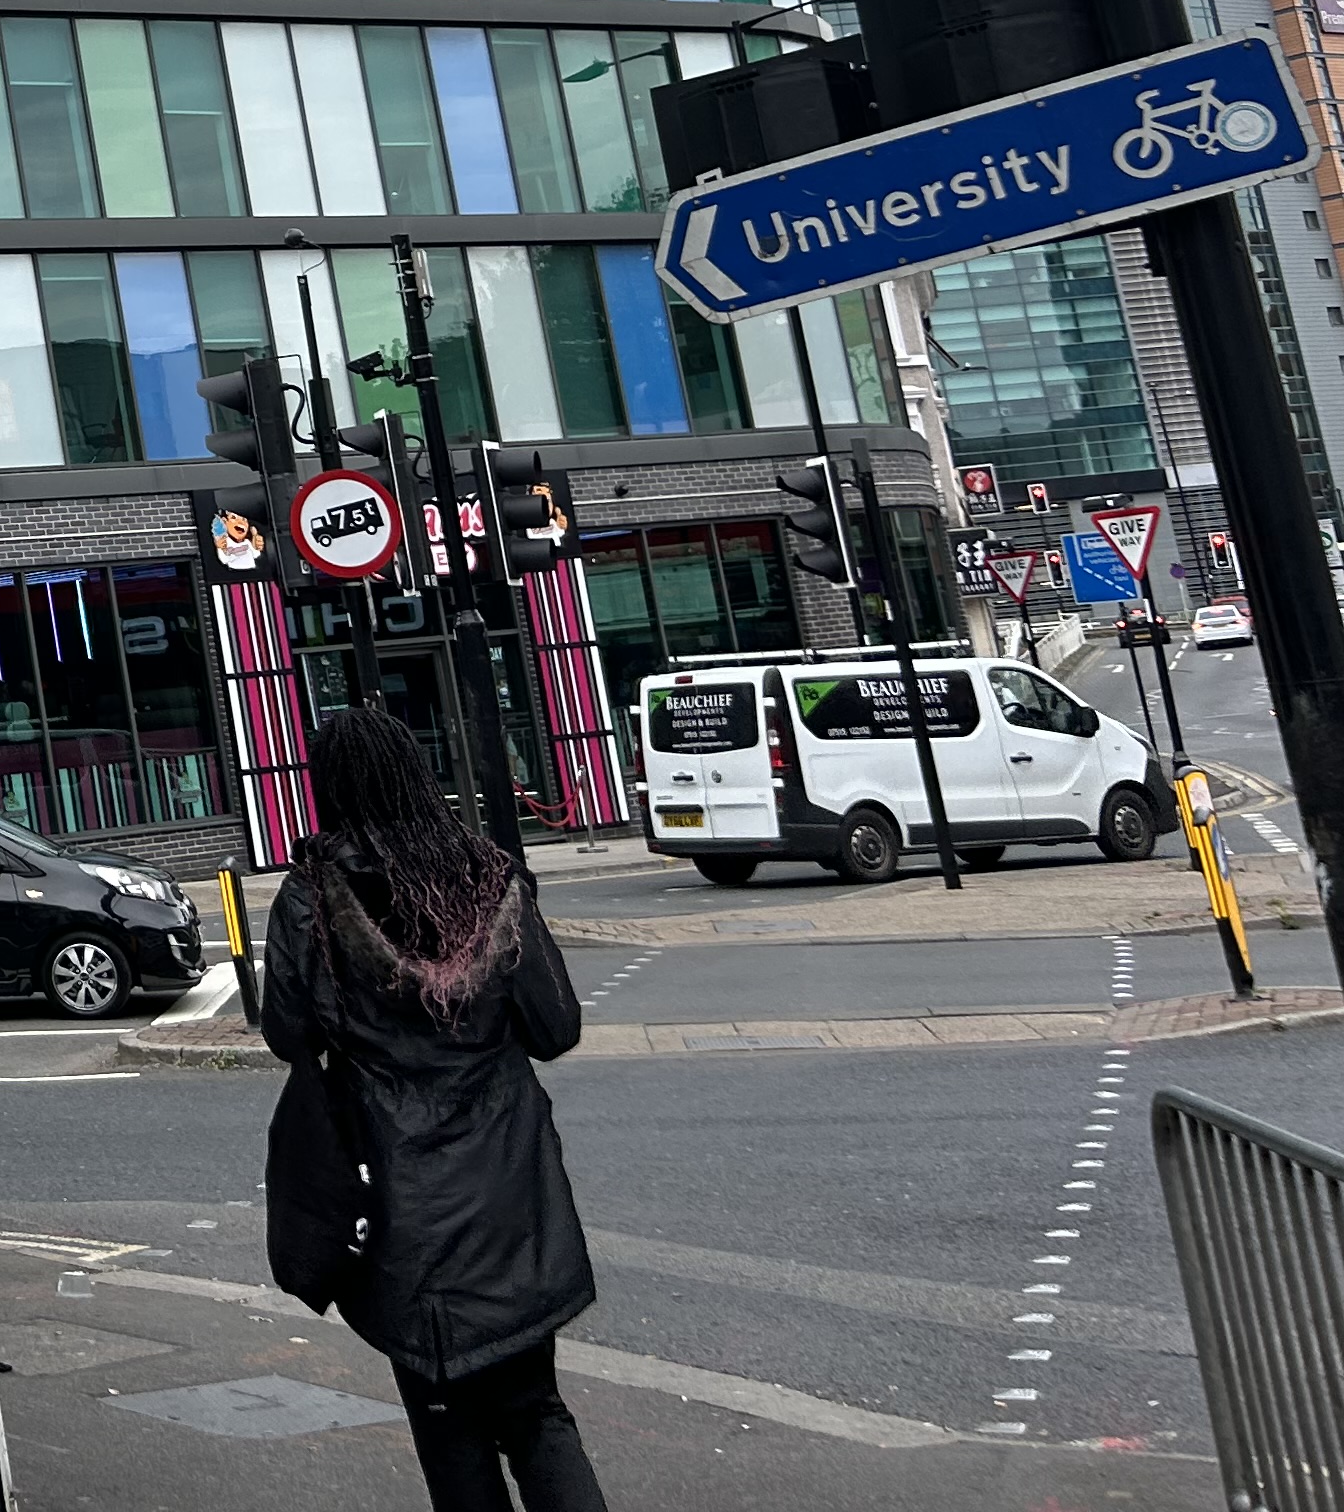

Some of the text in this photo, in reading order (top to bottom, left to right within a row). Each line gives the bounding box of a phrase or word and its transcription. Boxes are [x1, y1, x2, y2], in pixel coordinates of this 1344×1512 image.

[741, 144, 1072, 264] University
[1109, 518, 1146, 535] GIVE
[1118, 536, 1141, 547] WAY
[995, 558, 1026, 573] GIVE
[1004, 571, 1023, 580] WAY
[665, 693, 733, 710] BEAUCHIEF
[925, 707, 949, 718] UILD
